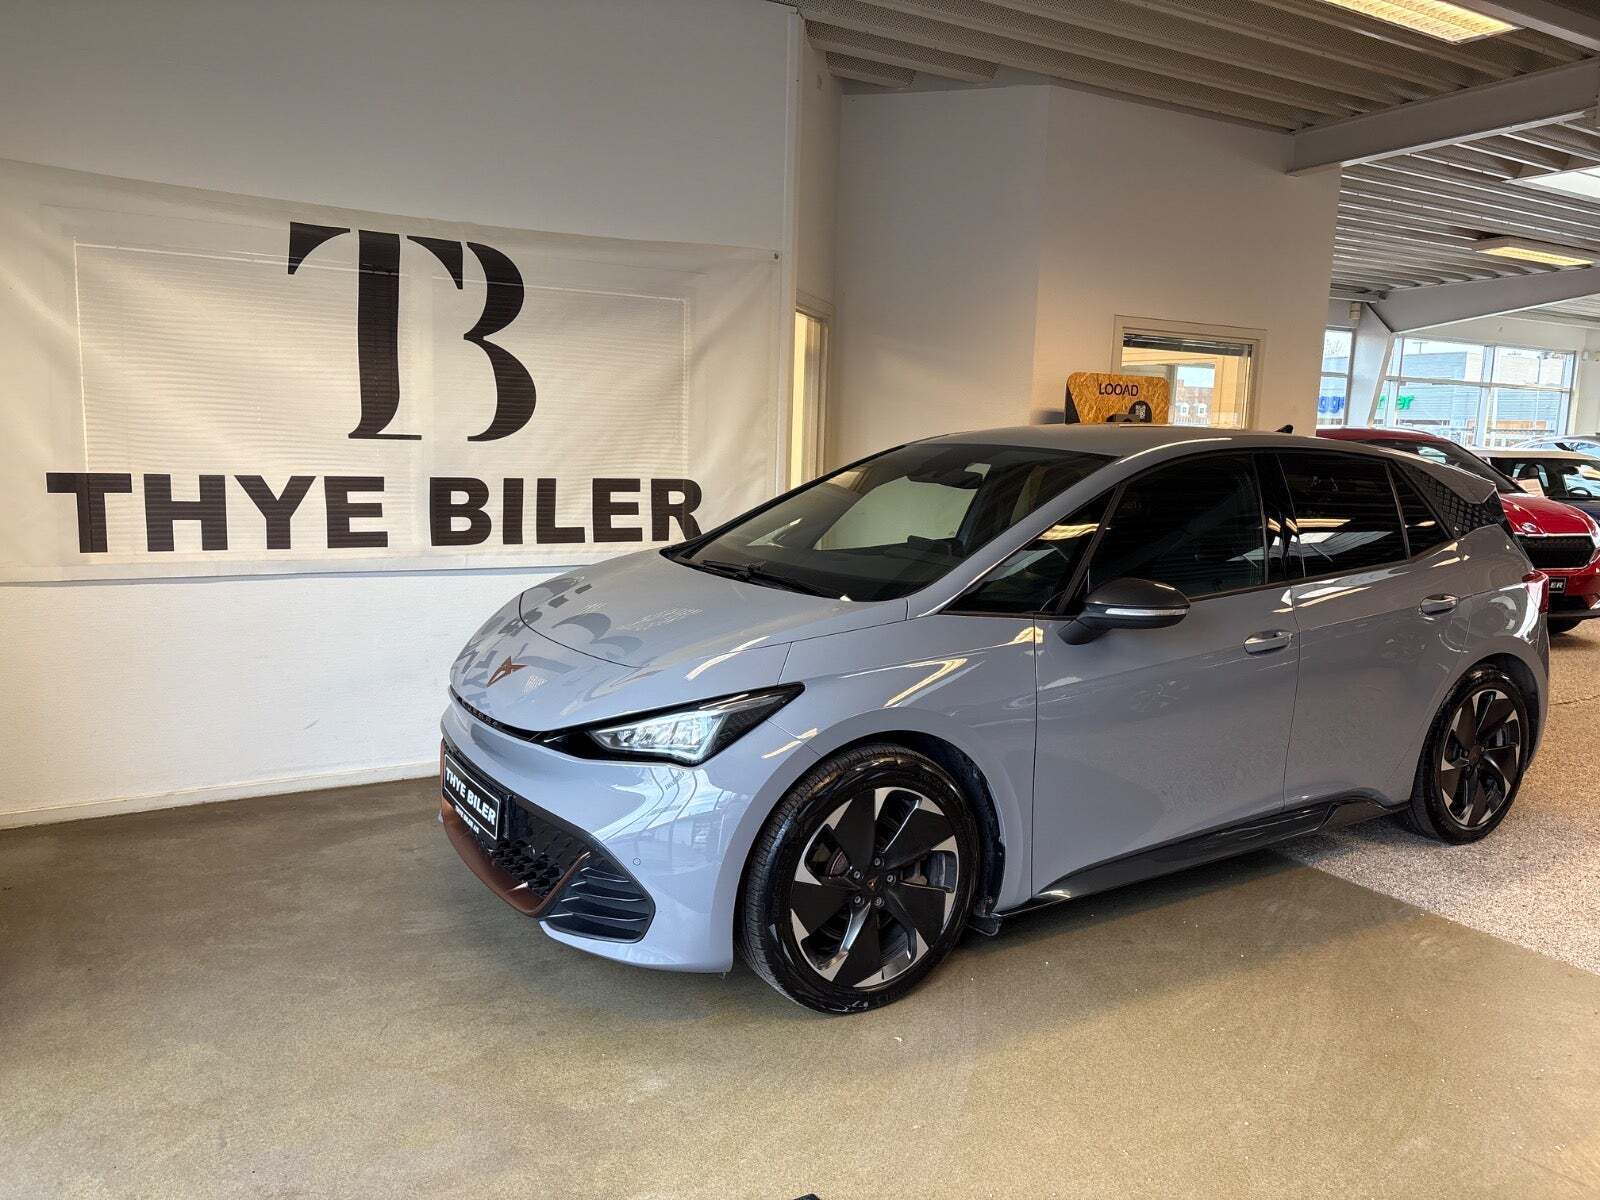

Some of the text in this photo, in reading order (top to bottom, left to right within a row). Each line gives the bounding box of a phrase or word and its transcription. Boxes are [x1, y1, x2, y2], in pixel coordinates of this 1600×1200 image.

[1098, 383, 1139, 397] LOOAD
[46, 472, 702, 553] THYE BILER
[446, 767, 466, 798] THYE
[467, 789, 496, 825] BILER
